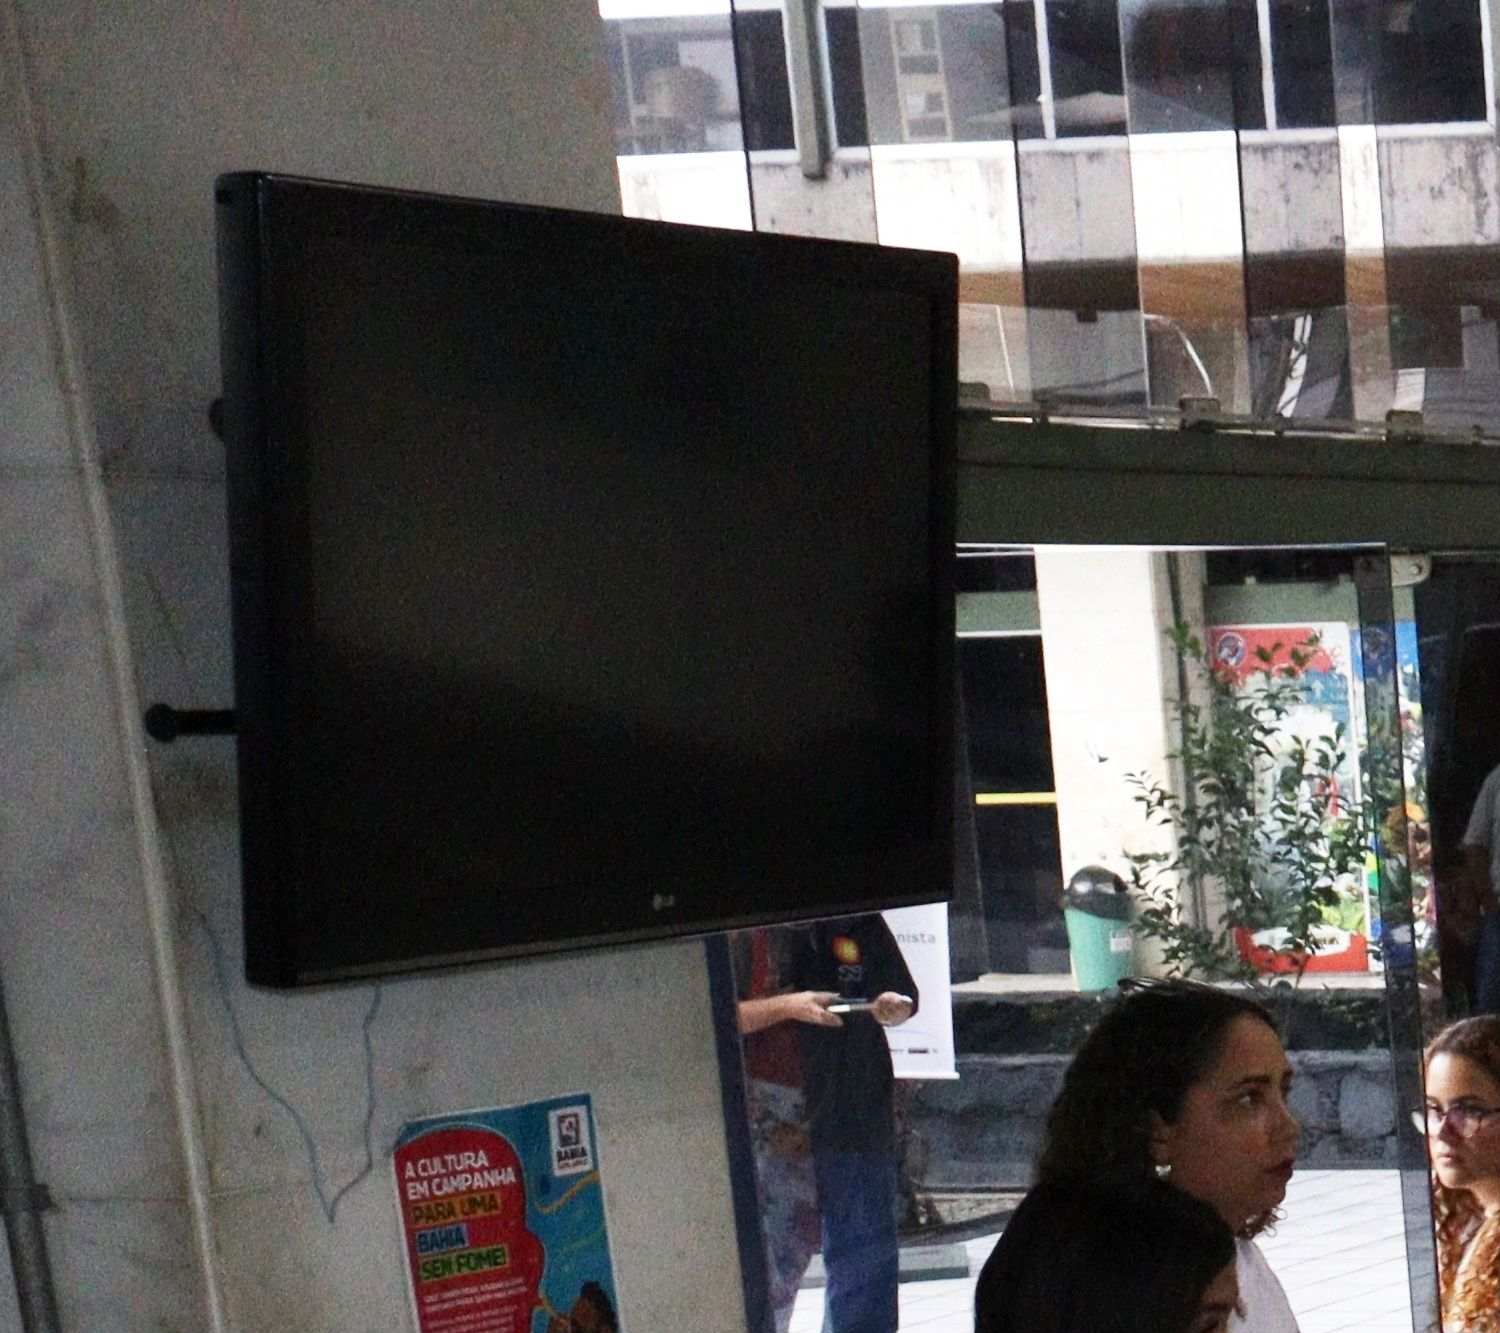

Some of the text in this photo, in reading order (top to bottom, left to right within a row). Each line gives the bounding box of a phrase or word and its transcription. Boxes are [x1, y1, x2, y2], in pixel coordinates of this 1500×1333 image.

[418, 1150, 488, 1177] CULTURA
[407, 1167, 516, 1201] EM CAMPANHA
[414, 1201, 457, 1224] PARA
[418, 1226, 465, 1253] BAHIA
